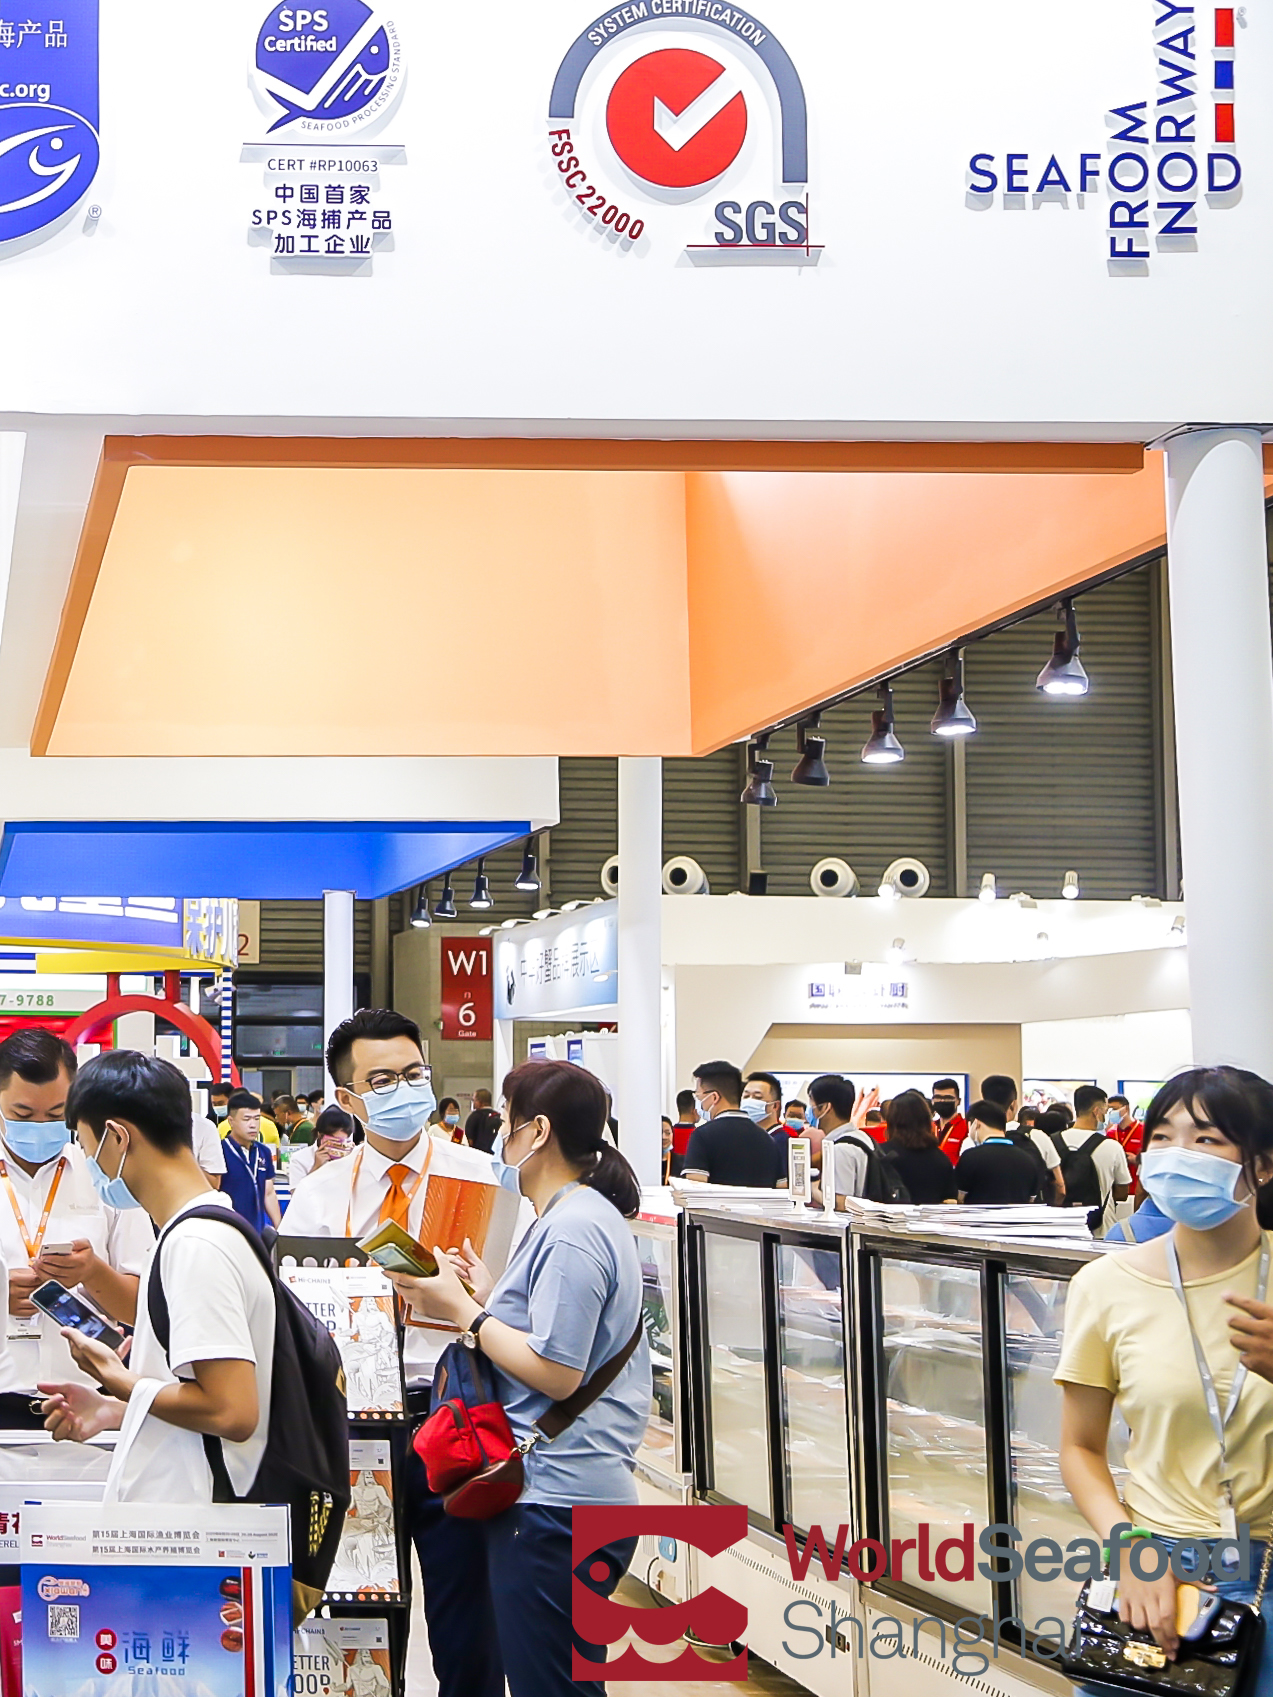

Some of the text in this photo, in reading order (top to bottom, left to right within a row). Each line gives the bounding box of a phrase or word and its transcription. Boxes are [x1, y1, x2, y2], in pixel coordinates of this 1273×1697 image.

[278, 9, 328, 32] SPS
[587, 0, 768, 46] SYSTEM CERTIFICATION
[264, 34, 337, 52] Certified
[301, 20, 401, 131] SEAFOOD PROCESSING STANDARD
[1155, 0, 1198, 234] NORWAY
[267, 158, 378, 172] CERT #RP10063
[969, 152, 1242, 193] SEAFOOD
[1108, 101, 1150, 258] FROM
[275, 183, 371, 205] 中国首家
[251, 208, 392, 230] SPS海捕产品
[714, 200, 807, 246] SGS
[274, 233, 371, 254] 加工企业
[447, 950, 487, 976] W1
[458, 1002, 476, 1026] 6
[306, 1303, 336, 1317] TTER
[128, 1666, 185, 1676] Seafood
[294, 1655, 330, 1671] ETTER
[294, 1673, 331, 1695] OOD
